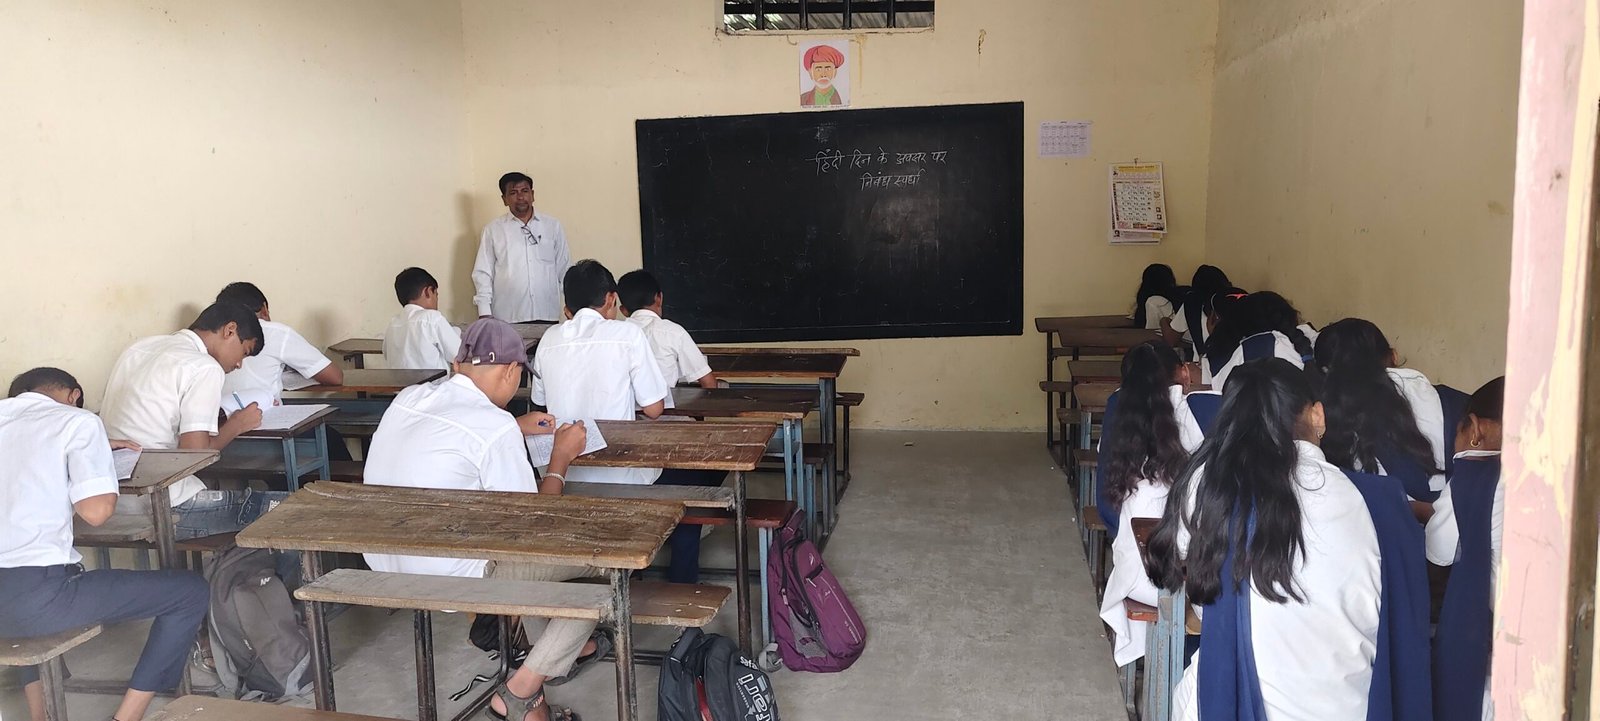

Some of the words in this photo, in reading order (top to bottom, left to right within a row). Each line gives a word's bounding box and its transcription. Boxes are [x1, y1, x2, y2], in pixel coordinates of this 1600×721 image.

[807, 149, 845, 175] हिंदी
[848, 149, 871, 169] दिन
[877, 146, 888, 164] के
[896, 152, 926, 164] अवसर
[931, 151, 947, 164] पर
[860, 171, 892, 191] निबंध
[740, 656, 758, 670] safa
